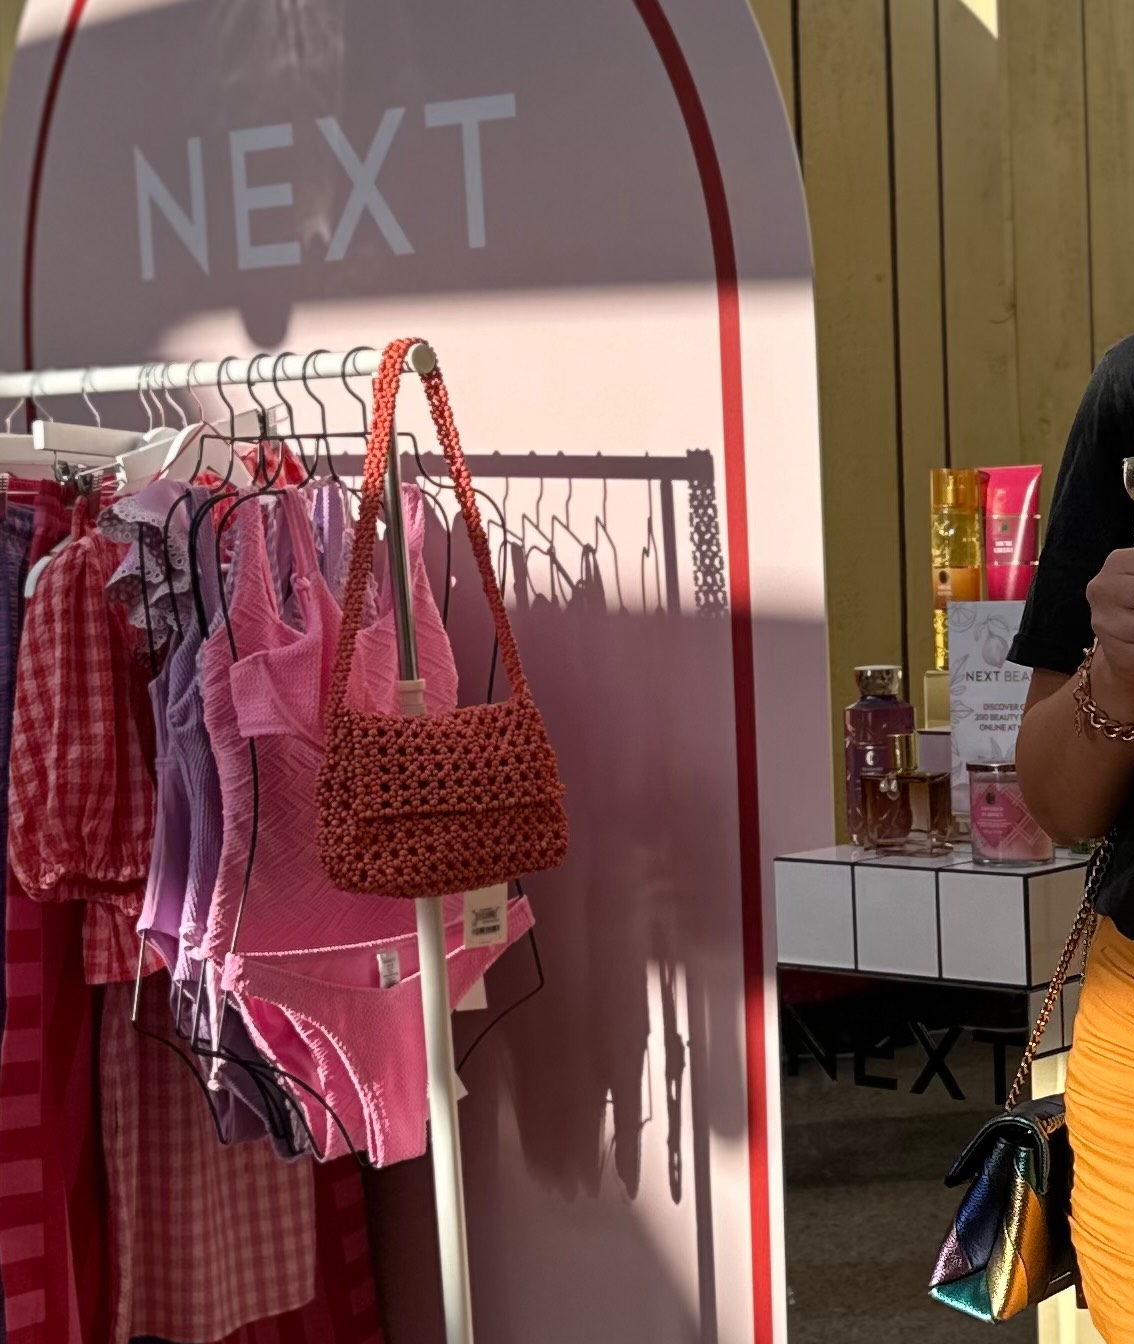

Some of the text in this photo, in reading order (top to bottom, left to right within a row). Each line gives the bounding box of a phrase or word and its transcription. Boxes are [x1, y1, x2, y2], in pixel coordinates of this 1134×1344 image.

[132, 93, 517, 281] NEXT
[965, 670, 1031, 682] NEXT BEA
[983, 703, 1019, 711] DISCOVER
[782, 1004, 1029, 1106] NEXT
